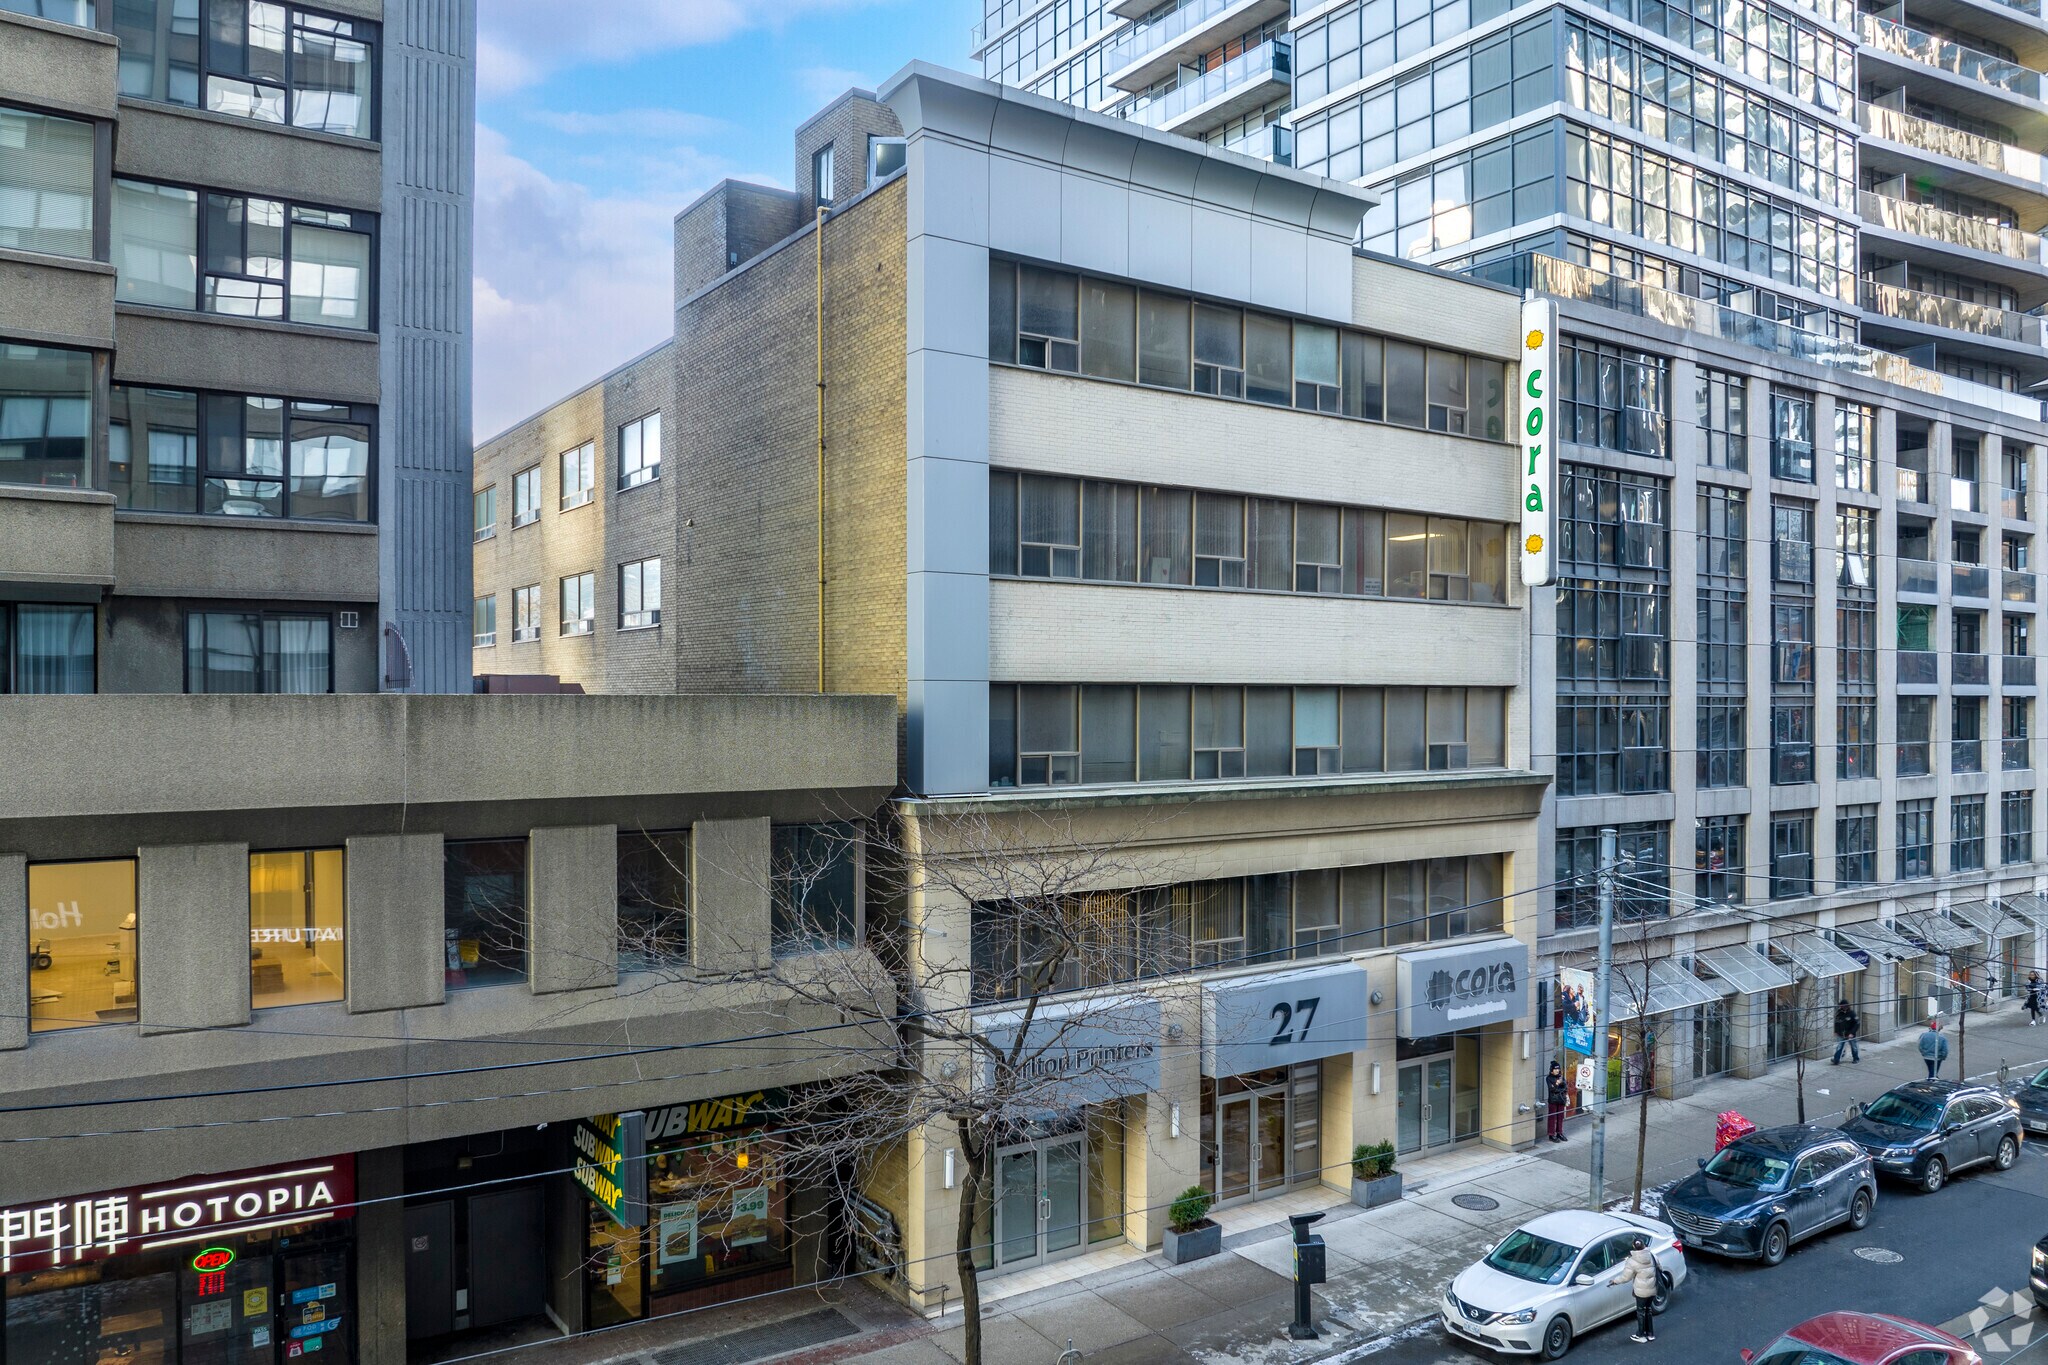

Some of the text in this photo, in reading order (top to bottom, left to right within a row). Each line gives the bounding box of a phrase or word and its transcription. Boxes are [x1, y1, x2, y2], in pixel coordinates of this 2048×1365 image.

[1525, 369, 1543, 513] cora
[1454, 961, 1516, 1000] cora
[1269, 997, 1321, 1047] 27
[1075, 1041, 1154, 1070] Printers
[645, 1091, 765, 1141] UBWAY
[574, 1123, 622, 1176] SUBWAY
[142, 1181, 335, 1235] HOTOPIA
[574, 1156, 623, 1210] SUBWAY
[195, 1251, 231, 1268] OPEN
